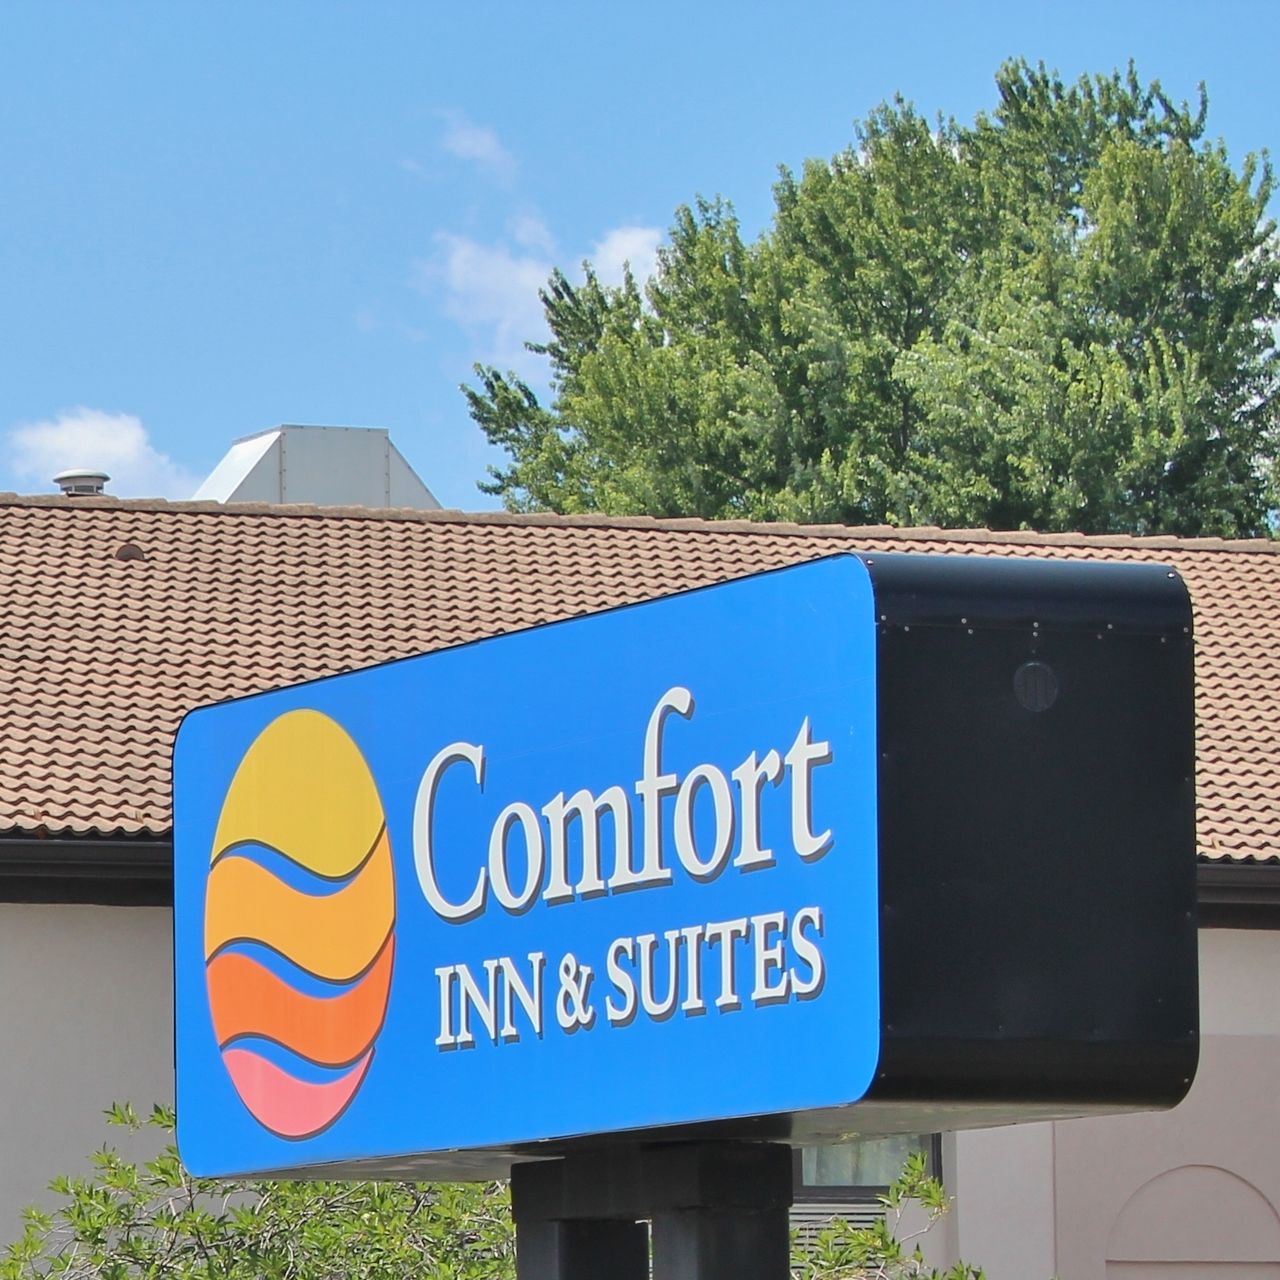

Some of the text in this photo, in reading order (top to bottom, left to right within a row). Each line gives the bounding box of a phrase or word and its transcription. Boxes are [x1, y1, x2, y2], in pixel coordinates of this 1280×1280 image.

[412, 687, 833, 921] Comfort
[434, 906, 825, 1050] INN & SUITES
